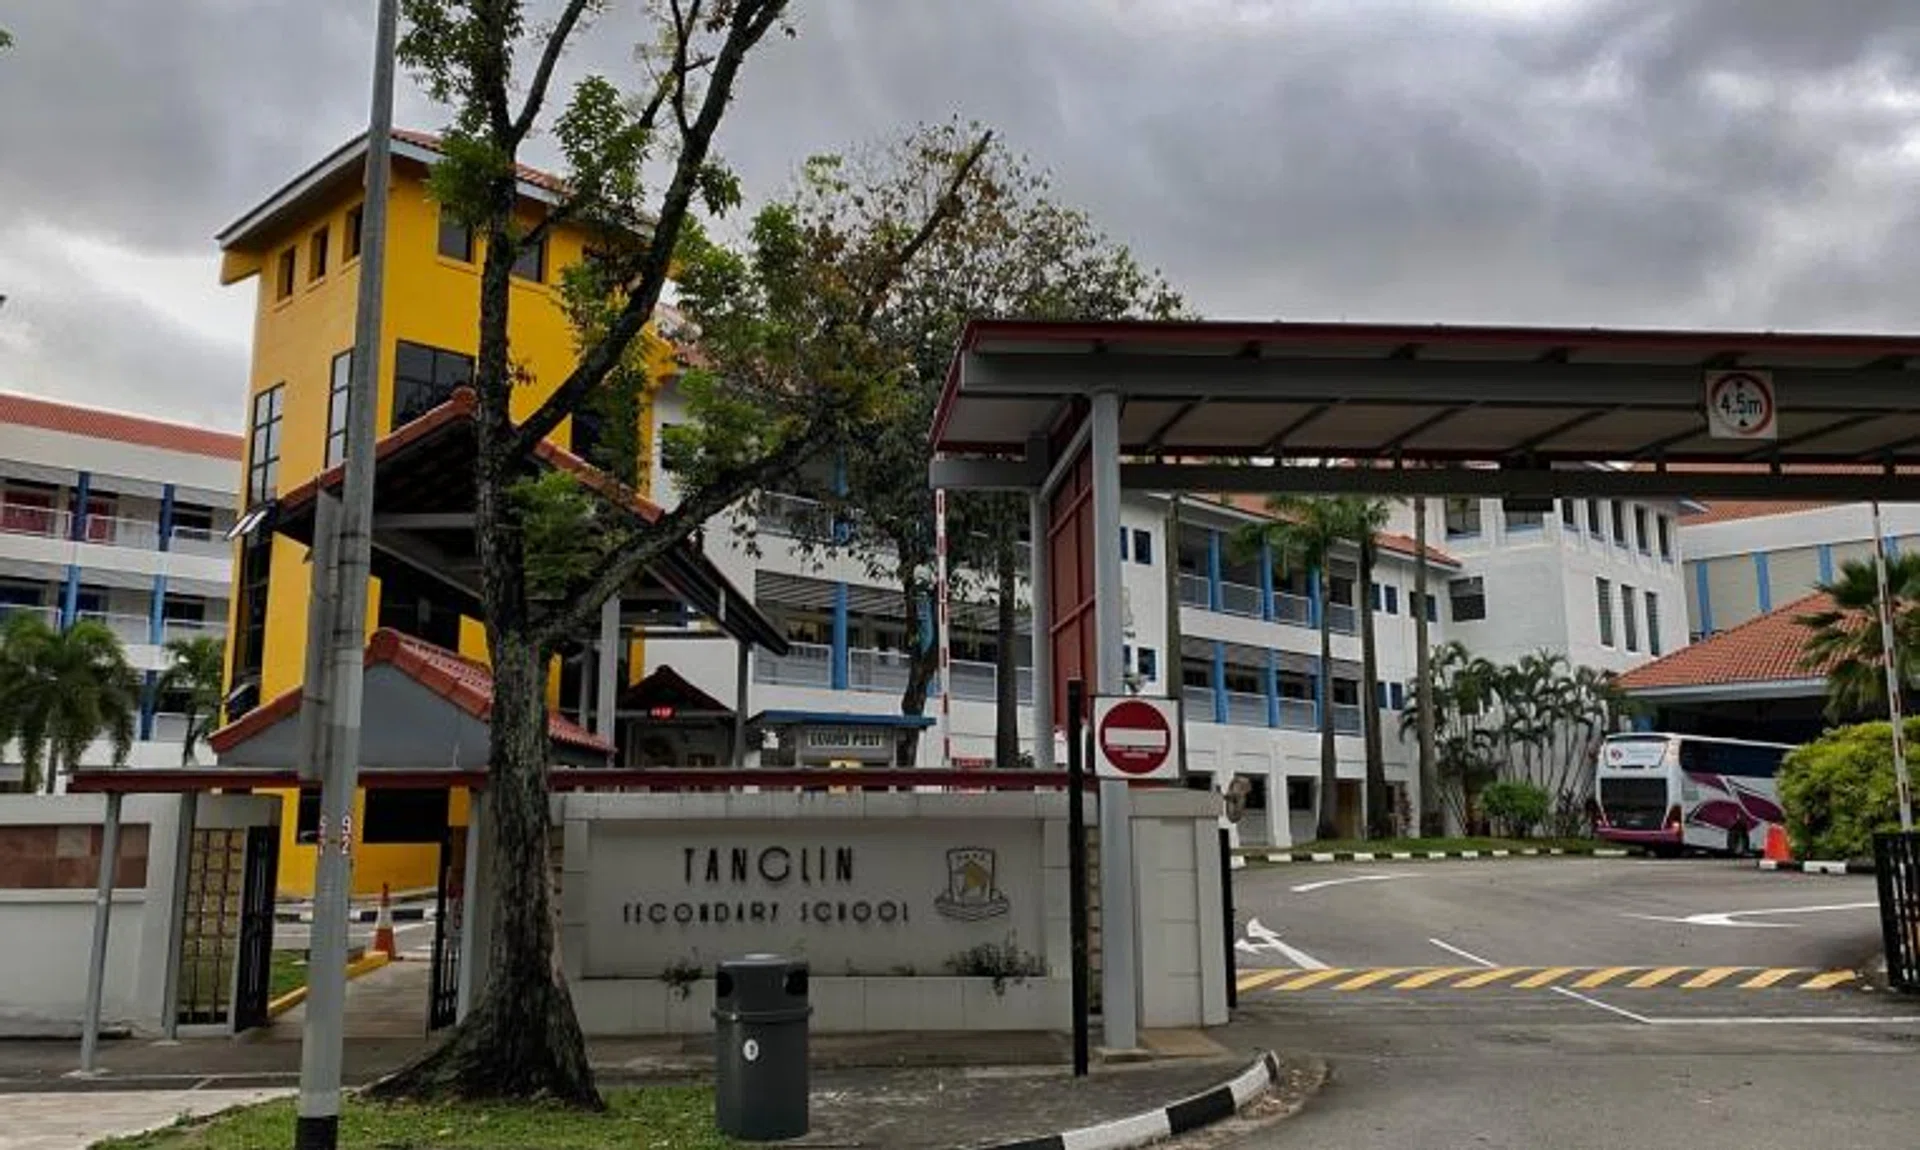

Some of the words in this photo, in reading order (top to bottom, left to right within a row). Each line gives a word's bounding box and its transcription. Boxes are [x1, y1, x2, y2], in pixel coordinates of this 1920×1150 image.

[1720, 392, 1763, 415] 4.5m
[684, 846, 852, 884] TANGLIN
[623, 902, 778, 924] SECONDARY
[801, 901, 908, 923] SCHOOL
